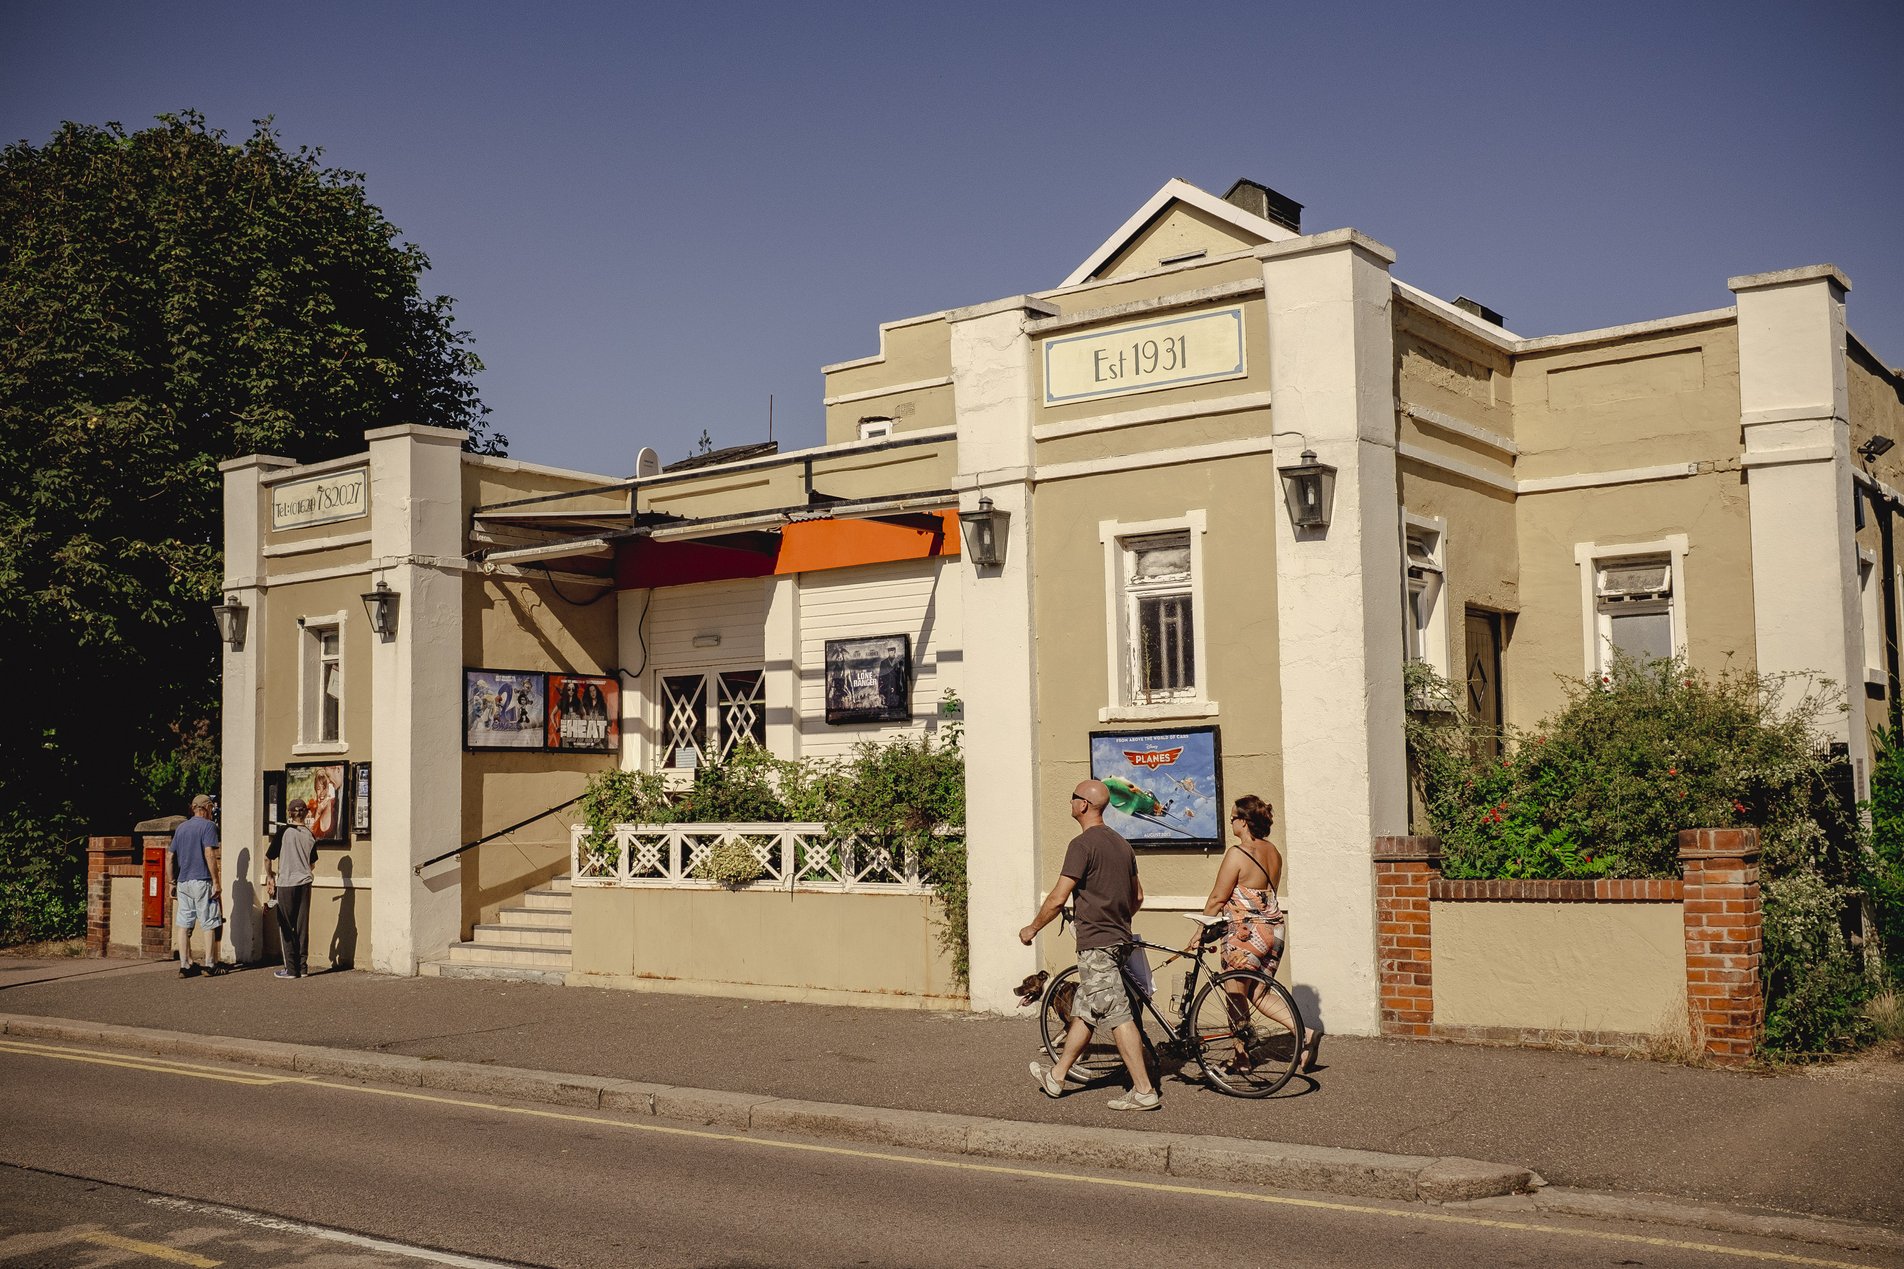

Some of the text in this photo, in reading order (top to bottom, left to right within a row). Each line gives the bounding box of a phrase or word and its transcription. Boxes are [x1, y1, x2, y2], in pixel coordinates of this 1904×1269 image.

[1131, 335, 1187, 376] 1931
[317, 482, 363, 511] 782027
[853, 678, 878, 688] RANGER
[857, 672, 873, 680] LONE
[566, 719, 608, 739] HEAT
[1135, 753, 1171, 764] PLANES
